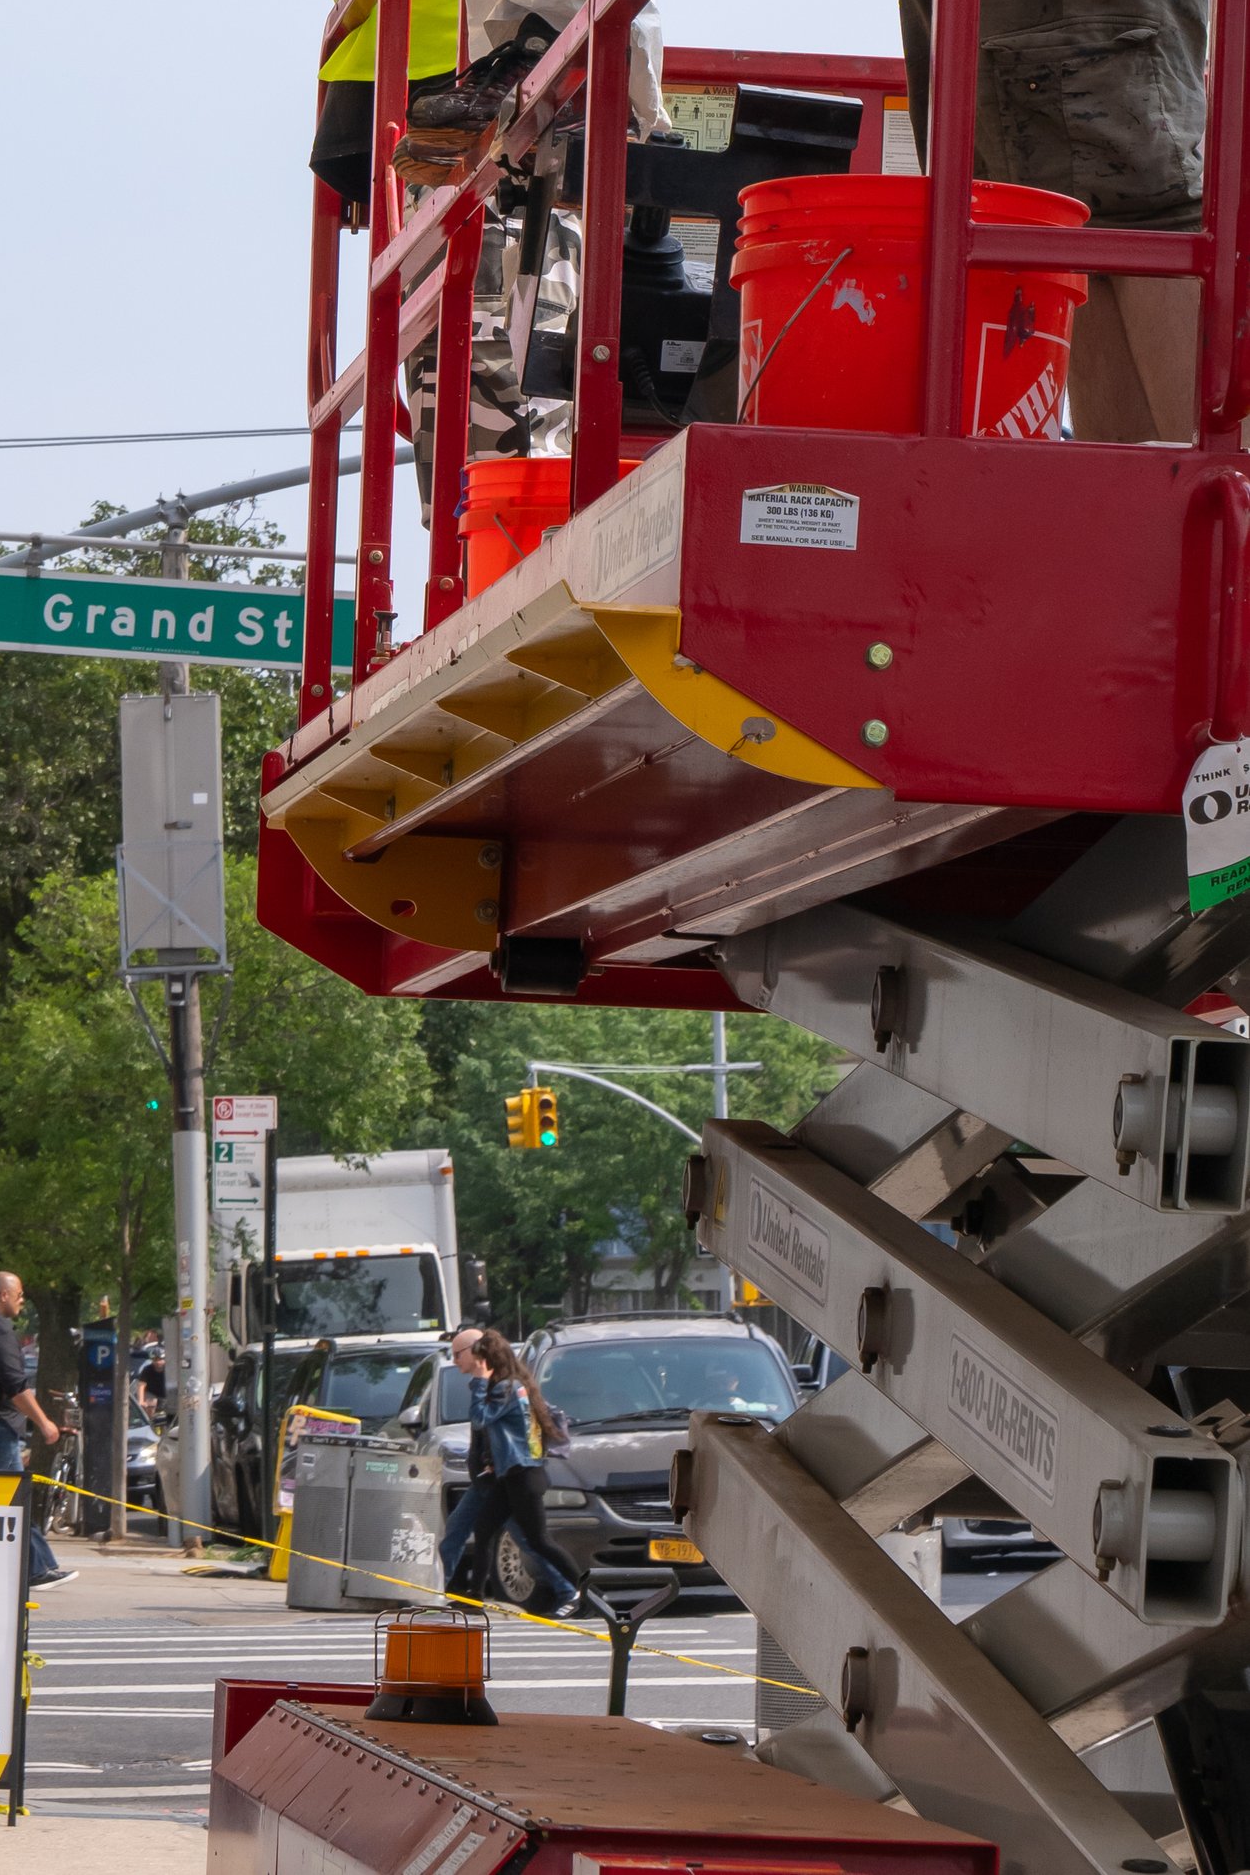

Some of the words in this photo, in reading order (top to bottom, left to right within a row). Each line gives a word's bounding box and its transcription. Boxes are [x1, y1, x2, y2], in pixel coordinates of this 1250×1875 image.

[788, 484, 827, 495] WARNING
[748, 494, 789, 504] MATERIAL
[790, 495, 812, 505] RACK
[814, 497, 854, 508] CAPACITY
[766, 506, 782, 515] 300
[783, 507, 799, 516] LBS
[800, 508, 818, 518] (136
[820, 509, 834, 521] KG)
[603, 512, 637, 582] United
[636, 488, 676, 559] Rentals
[765, 535, 793, 543] MANUAL
[795, 536, 809, 544] FOR
[43, 592, 215, 643] Grand
[234, 605, 293, 649] St
[1194, 768, 1232, 784] THINK
[218, 1144, 229, 1162] 2
[762, 1203, 792, 1261] United
[791, 1226, 825, 1288] Rentals
[951, 1349, 1056, 1482] 1-800-UR-RENTS
